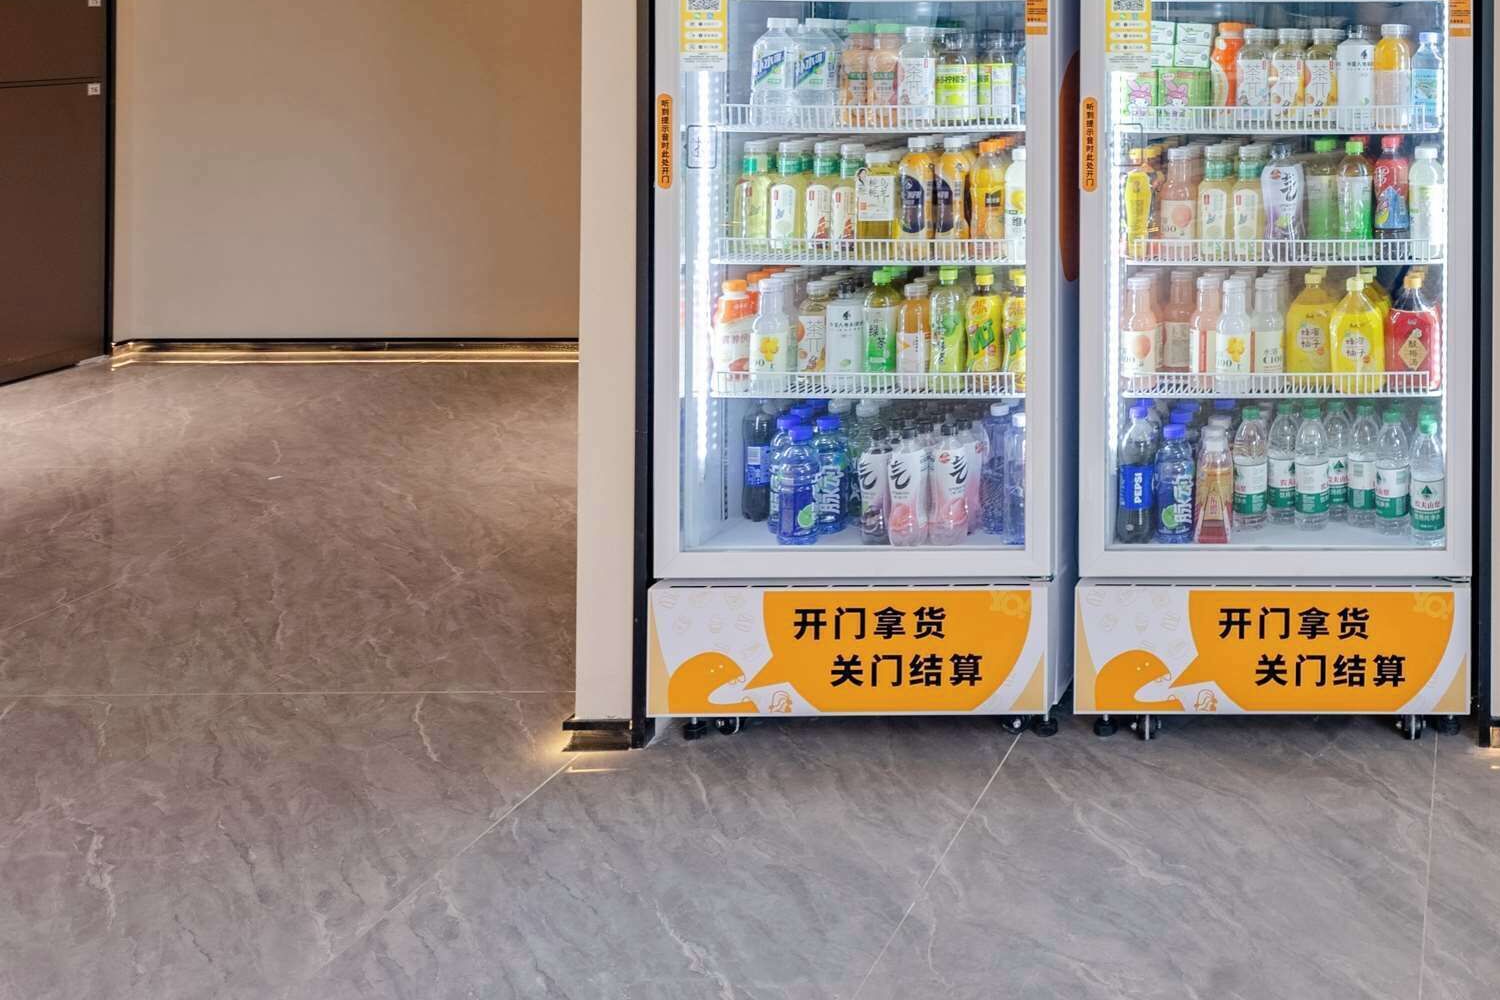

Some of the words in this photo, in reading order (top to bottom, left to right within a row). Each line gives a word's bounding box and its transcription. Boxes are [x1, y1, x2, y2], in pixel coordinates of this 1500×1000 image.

[1134, 472, 1143, 504] PEPSI
[793, 607, 947, 640] 开门拿货
[1218, 607, 1370, 639] 开门拿货
[830, 654, 983, 687] 关门结算
[1254, 654, 1406, 687] 关门结算
